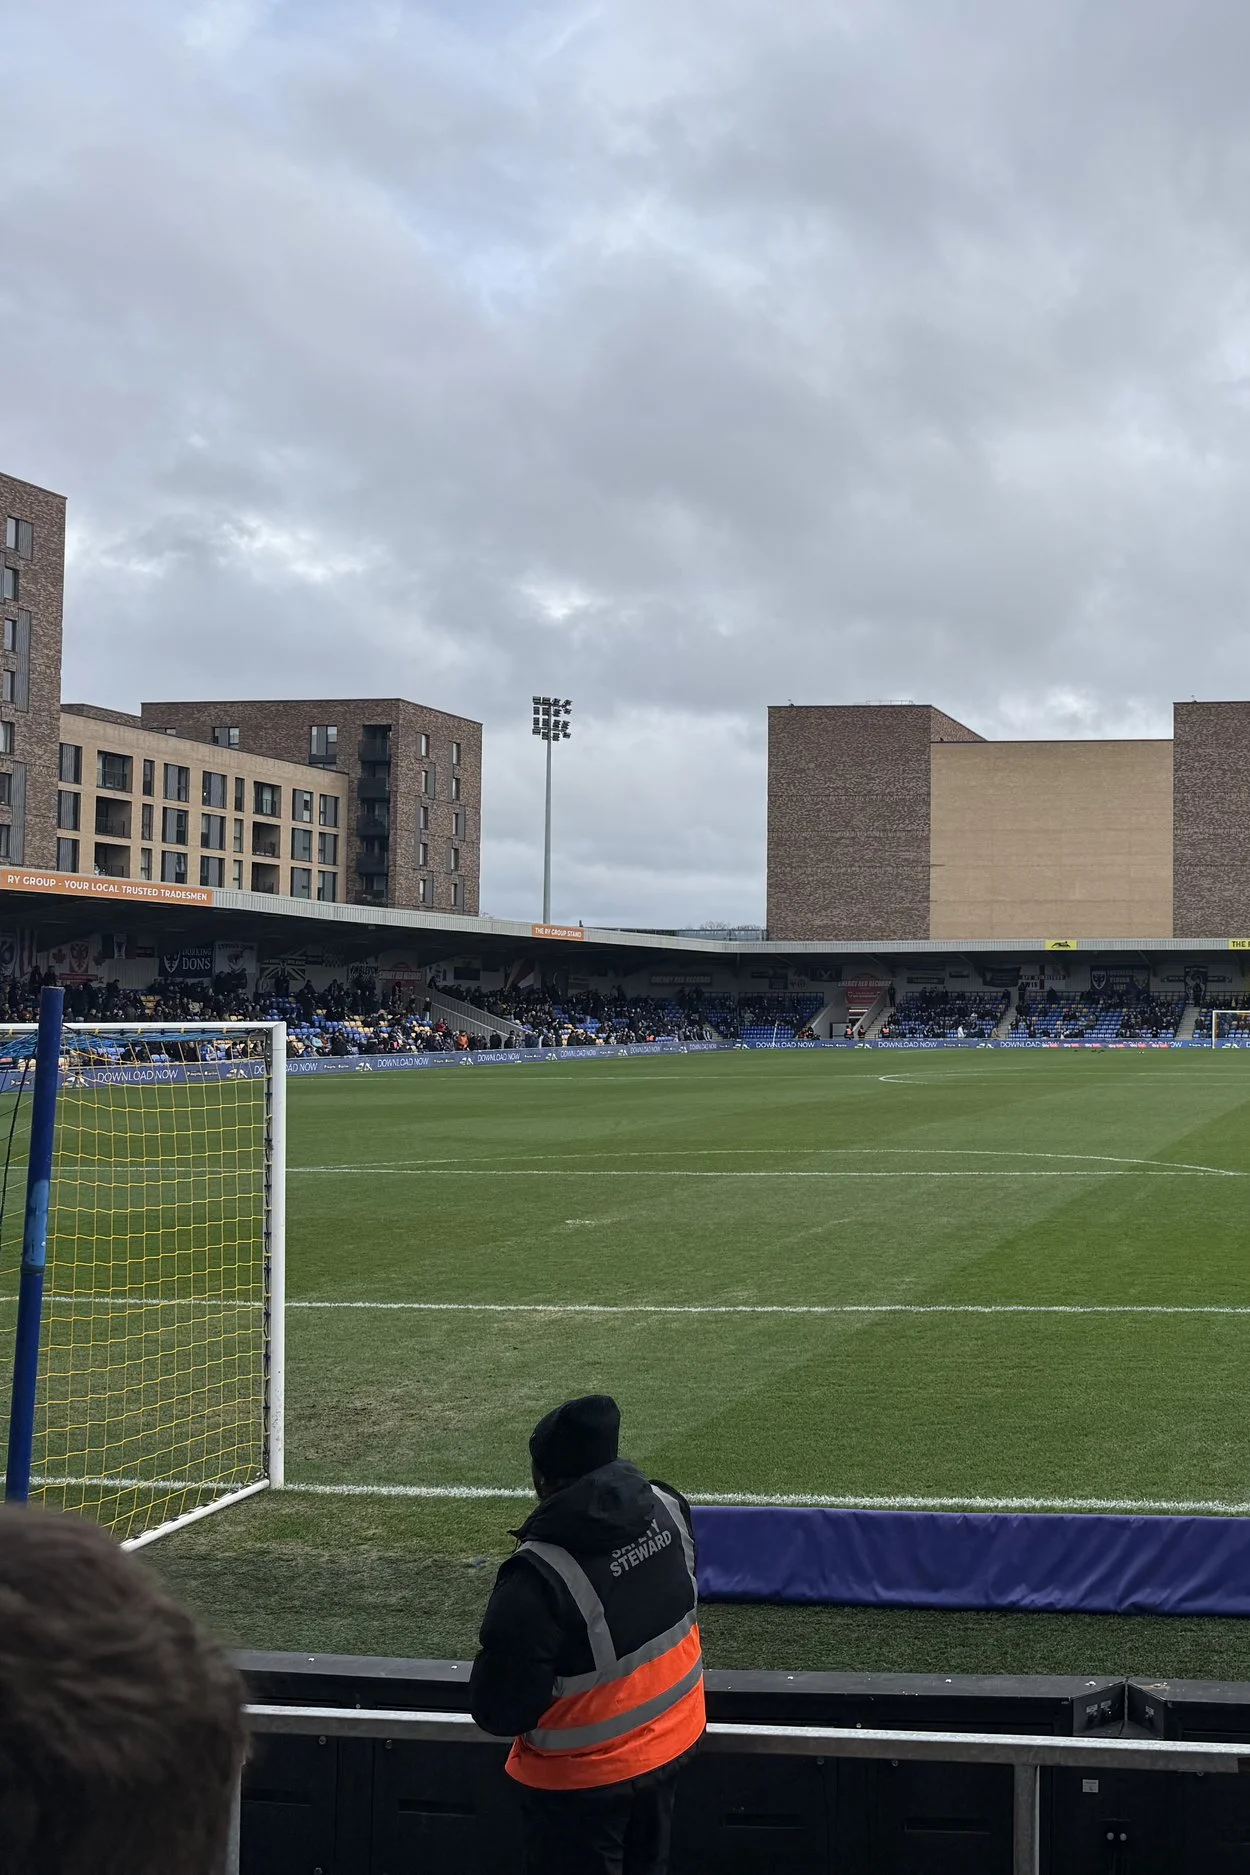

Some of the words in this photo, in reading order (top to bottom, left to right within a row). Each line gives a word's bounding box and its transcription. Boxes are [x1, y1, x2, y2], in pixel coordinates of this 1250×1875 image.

[7, 874, 20, 884] RY
[23, 876, 56, 887] GROUP
[64, 880, 89, 891] YOUR
[91, 882, 120, 893] LOCAL
[121, 885, 159, 896] TRUSTED
[160, 889, 208, 901] TRADESMEN
[1232, 940, 1246, 948] THE
[182, 957, 211, 970] DONS
[300, 1062, 318, 1072] NOW
[377, 1057, 413, 1068] DOWNLOAD
[414, 1056, 429, 1066] NOW
[97, 1070, 154, 1083] DOWNLOAD
[156, 1069, 179, 1080] NOW
[609, 1530, 672, 1577] STEWARD
